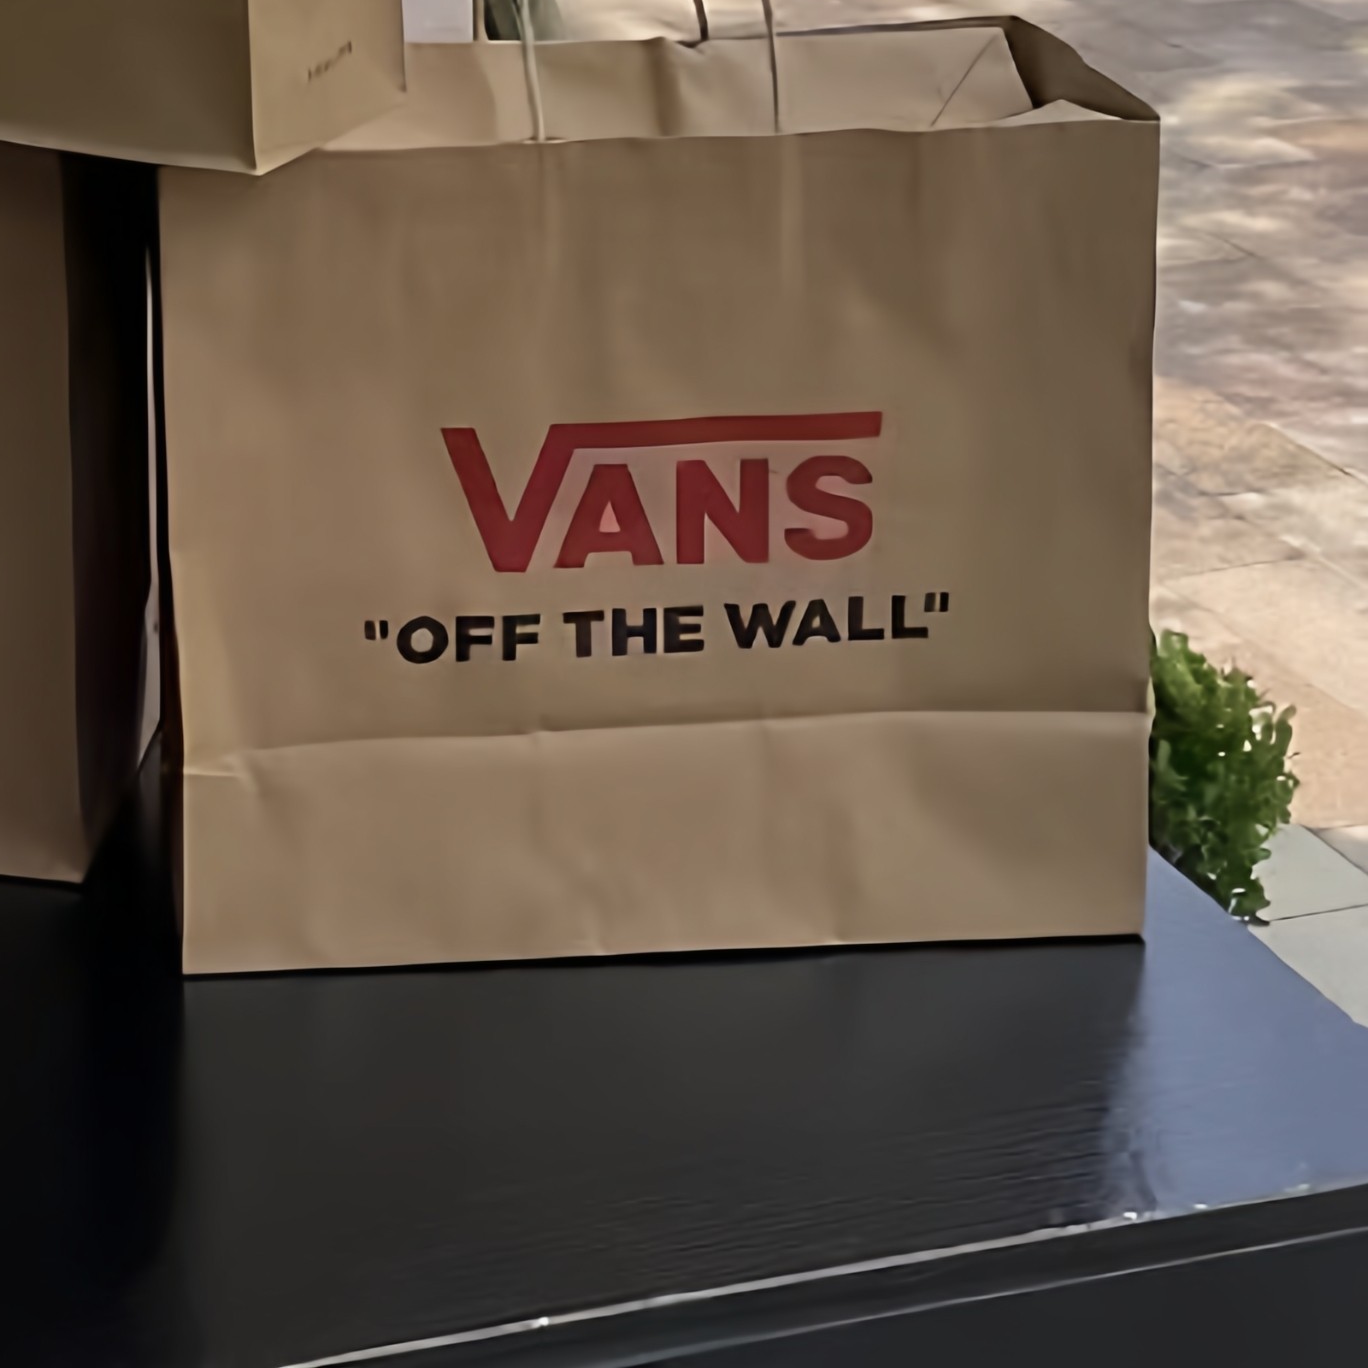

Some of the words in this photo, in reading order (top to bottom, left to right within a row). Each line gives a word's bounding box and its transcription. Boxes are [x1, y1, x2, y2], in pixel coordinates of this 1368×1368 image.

[440, 411, 883, 573] VANS
[364, 614, 541, 664] "OFF
[563, 605, 704, 658] THE
[724, 592, 949, 649] WALL"
